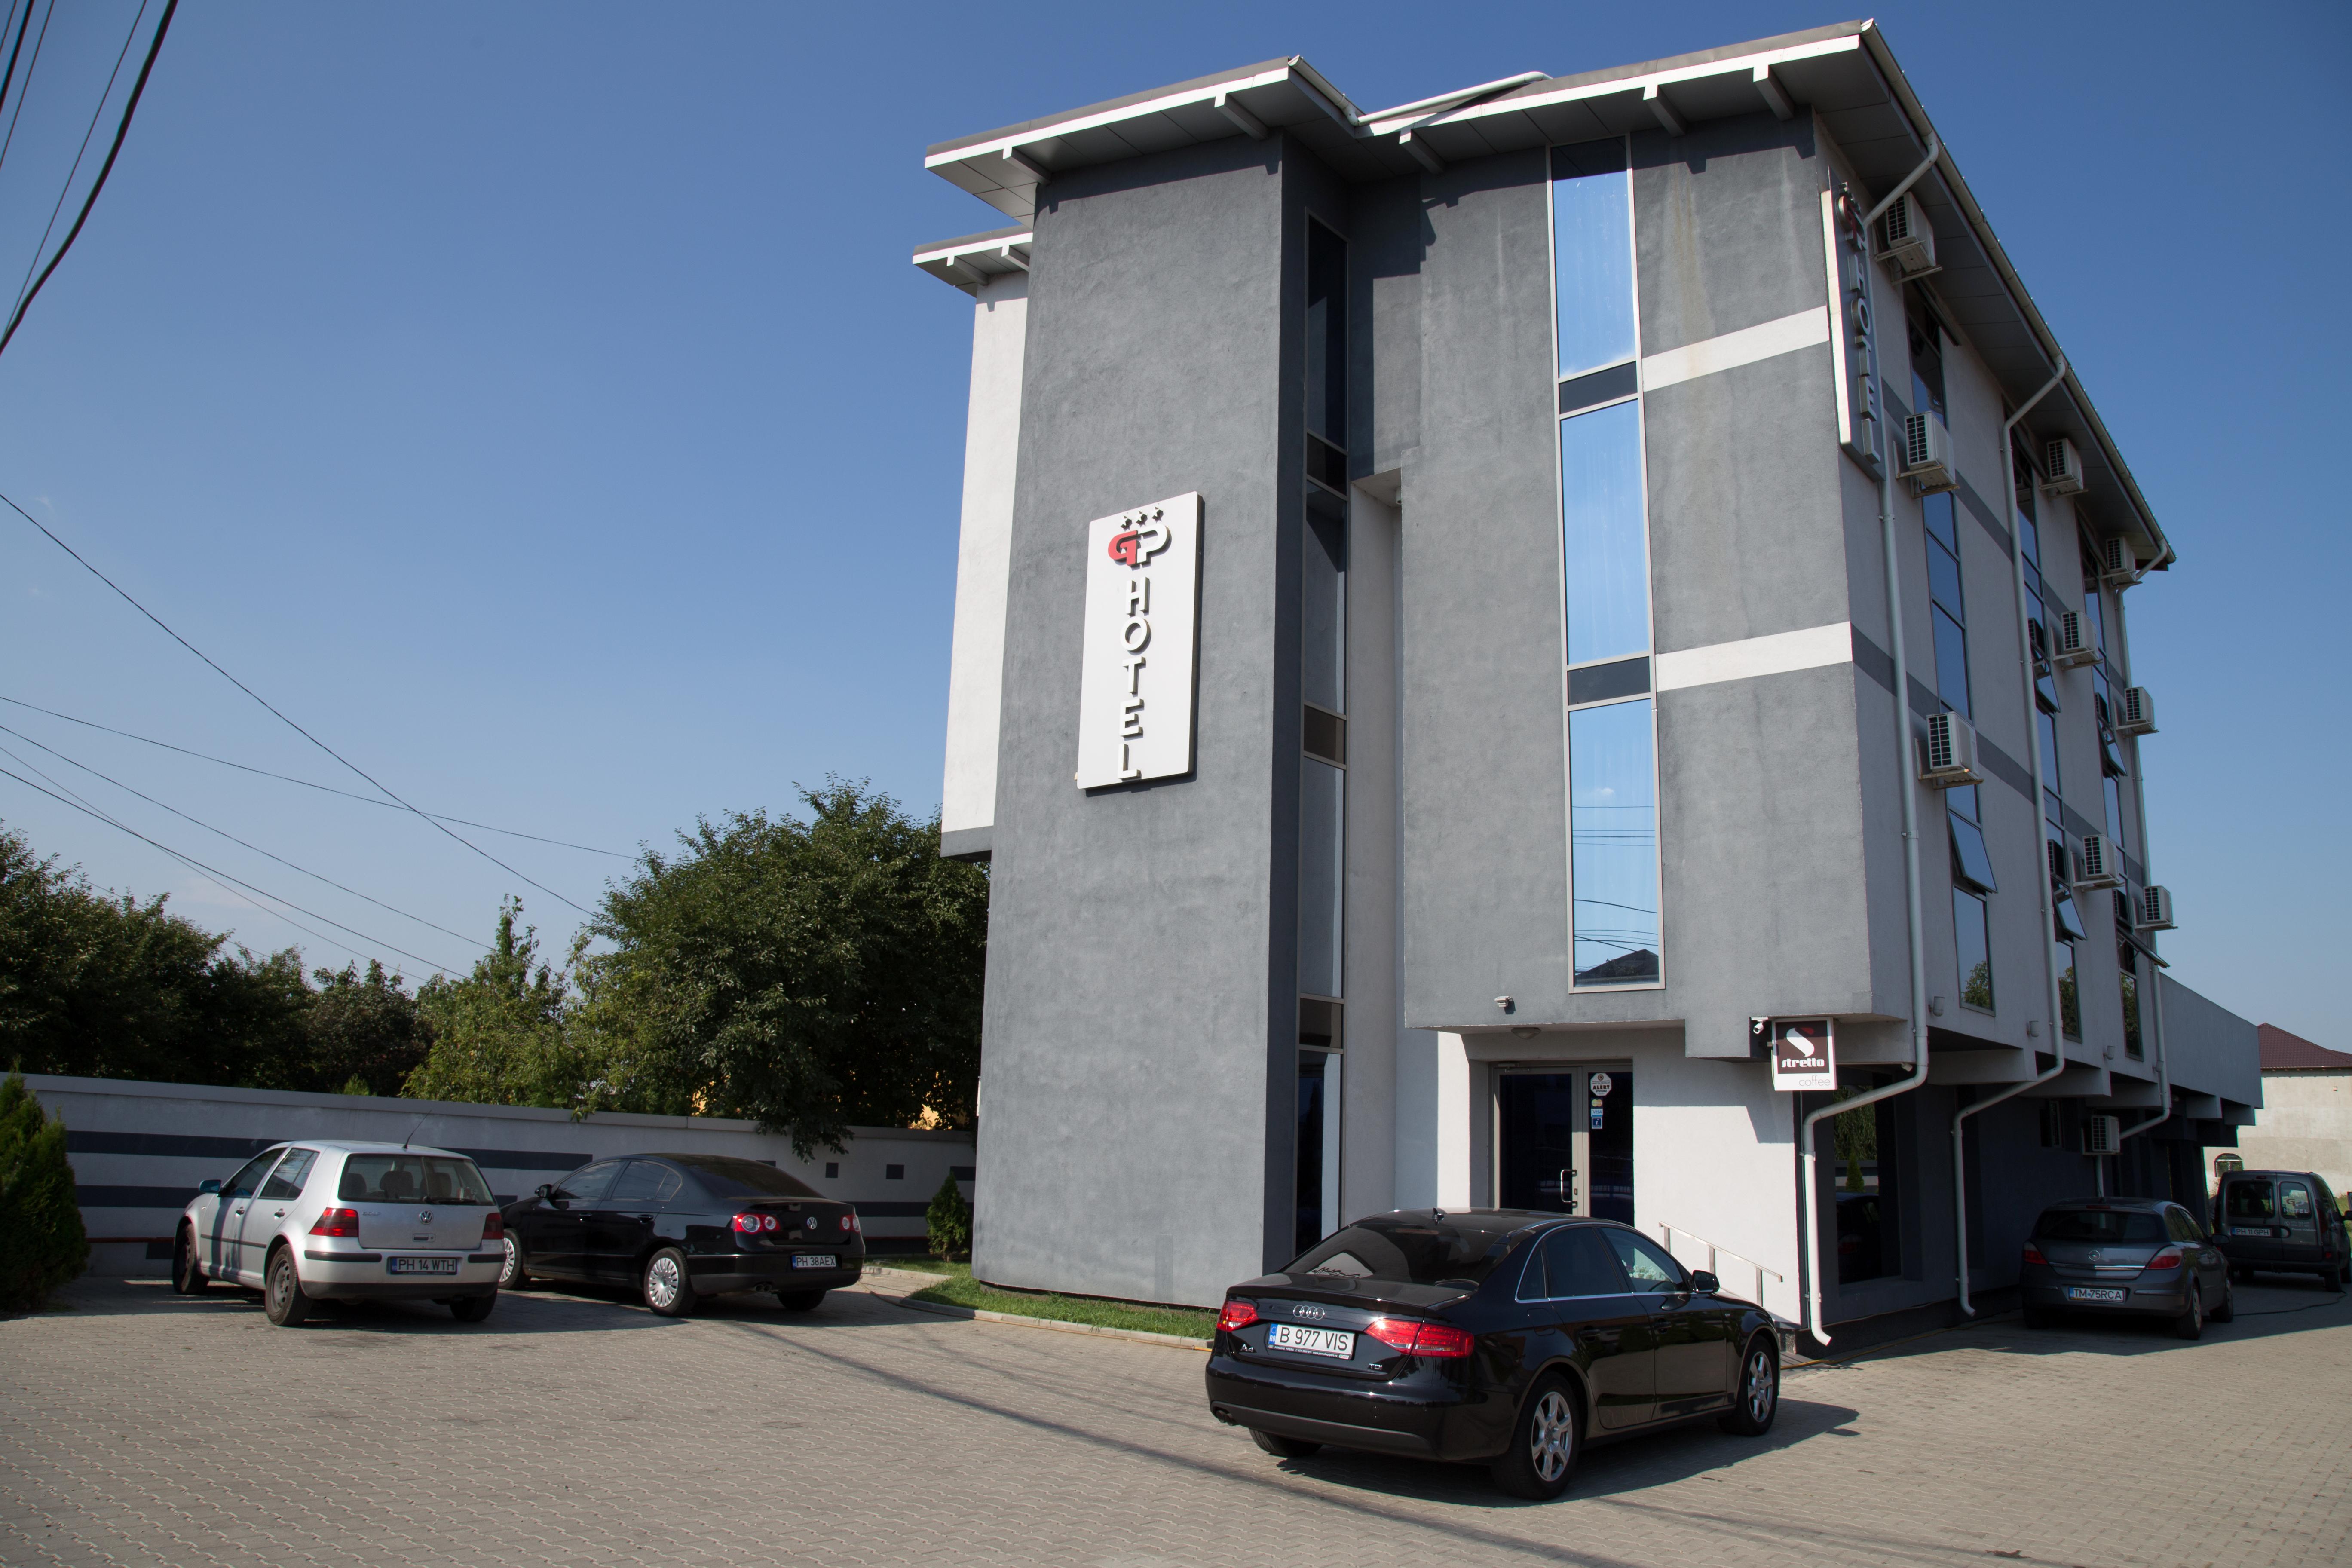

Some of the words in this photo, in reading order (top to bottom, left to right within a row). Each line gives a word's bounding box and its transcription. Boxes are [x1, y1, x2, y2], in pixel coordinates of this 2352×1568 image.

[1848, 254, 1880, 464] HOTEL
[1118, 577, 1151, 780] HOTEL
[1782, 1058, 1825, 1068] stretto
[1799, 1075, 1831, 1087] coffee
[399, 1259, 415, 1270] PH
[419, 1259, 429, 1270] 14
[432, 1260, 455, 1271] WTH
[796, 1257, 808, 1266] PH
[2074, 1289, 2087, 1297] TM
[2090, 1290, 2122, 1299] 75RCA
[1280, 1327, 1290, 1343] B
[1295, 1329, 1320, 1347] 977
[1326, 1332, 1348, 1351] VIS
[1240, 1344, 1254, 1353] A4
